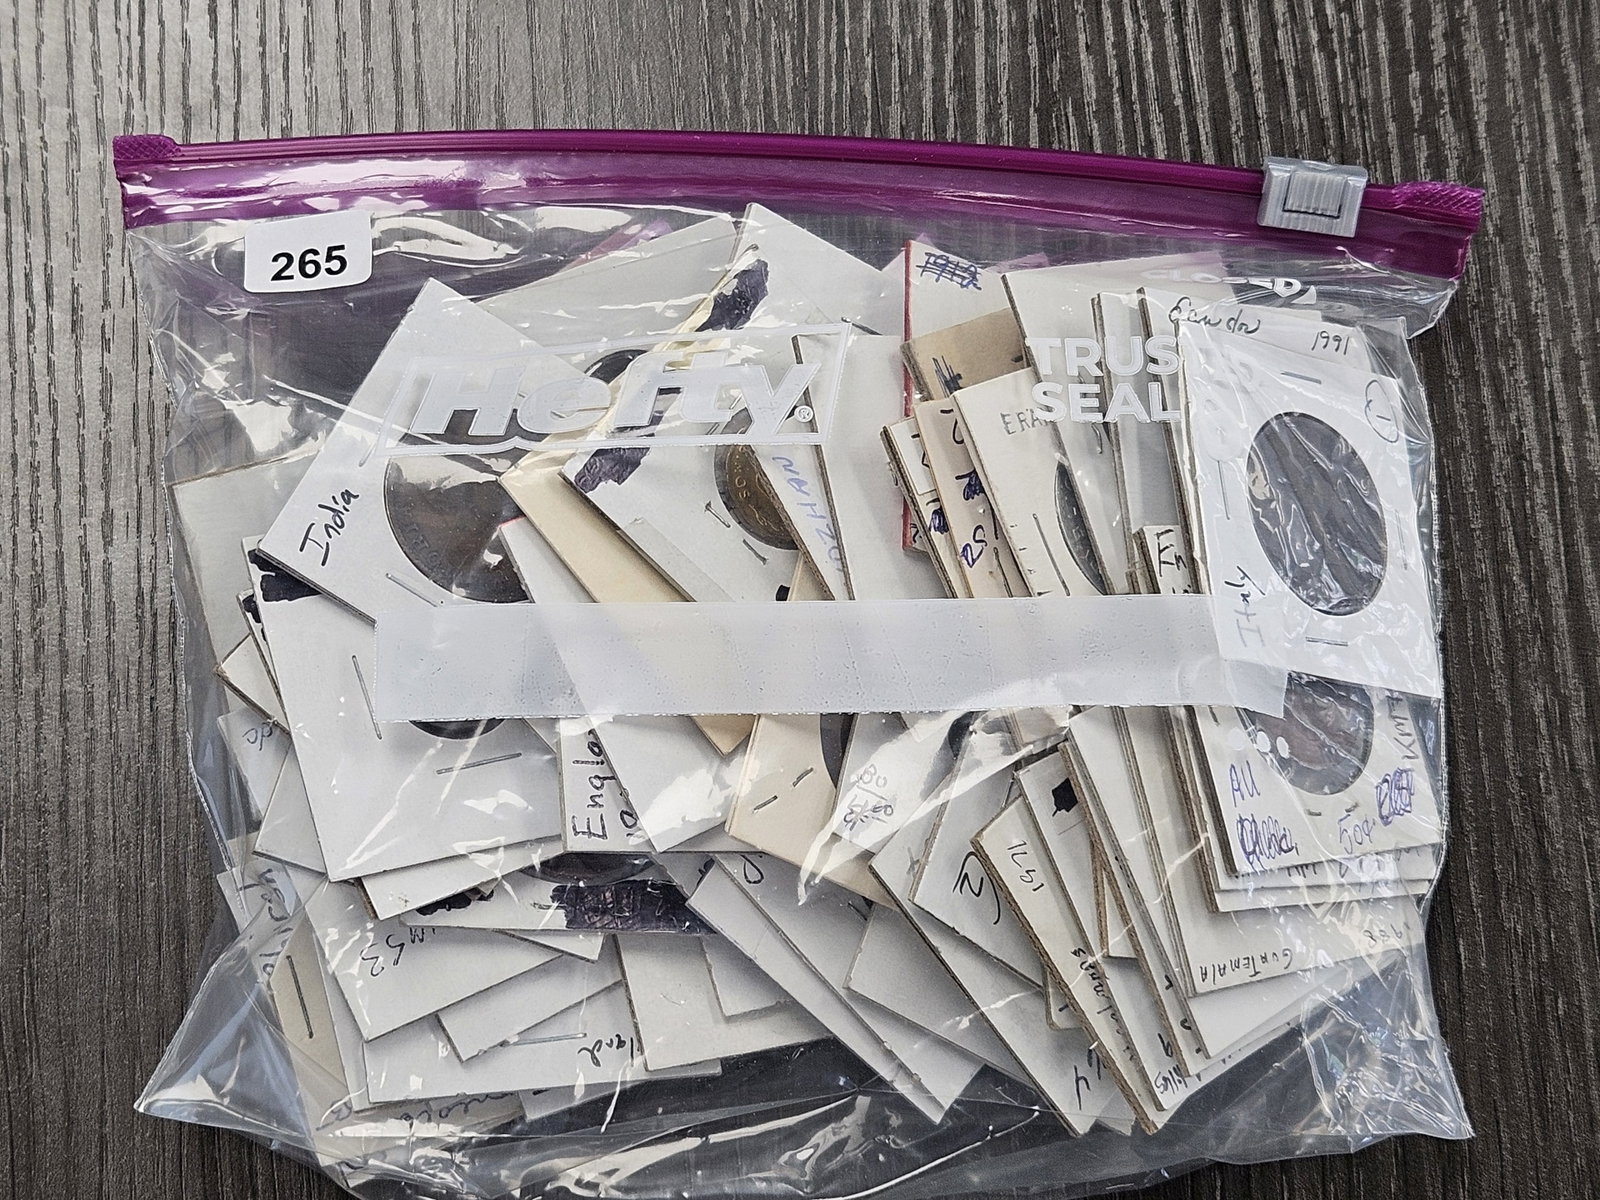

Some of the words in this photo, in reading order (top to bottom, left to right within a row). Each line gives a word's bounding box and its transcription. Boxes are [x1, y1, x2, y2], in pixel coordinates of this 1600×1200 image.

[270, 244, 349, 281] 265
[1310, 330, 1350, 356] 1991
[409, 348, 821, 437] Hefty
[1031, 381, 1181, 423] SEAL
[299, 487, 361, 568] India
[1225, 565, 1267, 648] Italy
[571, 728, 617, 841] Engla
[576, 1033, 635, 1067] land
